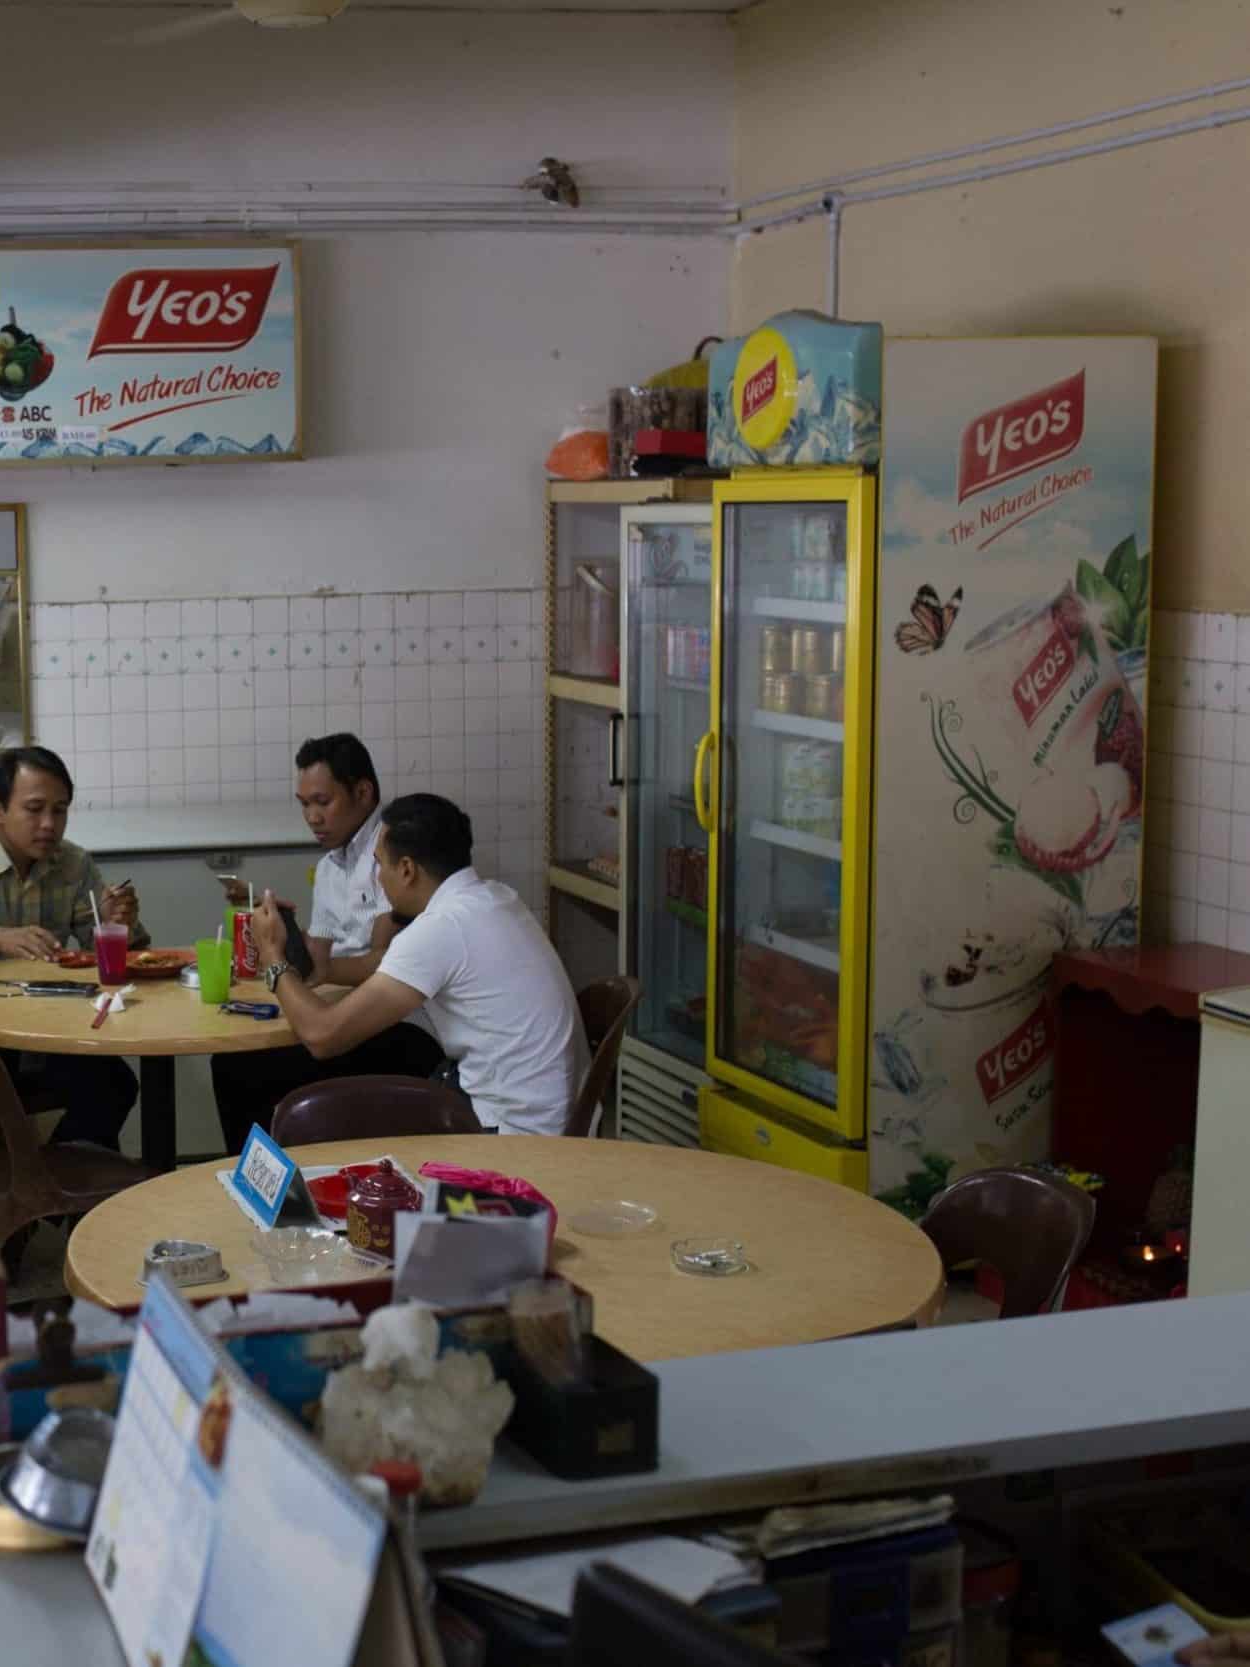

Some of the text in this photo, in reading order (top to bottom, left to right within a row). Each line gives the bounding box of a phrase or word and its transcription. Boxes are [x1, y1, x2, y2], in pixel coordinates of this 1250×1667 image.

[20, 405, 53, 422] ABC
[74, 366, 281, 416] The Natural Choice
[949, 466, 1094, 545] The Natural Choice
